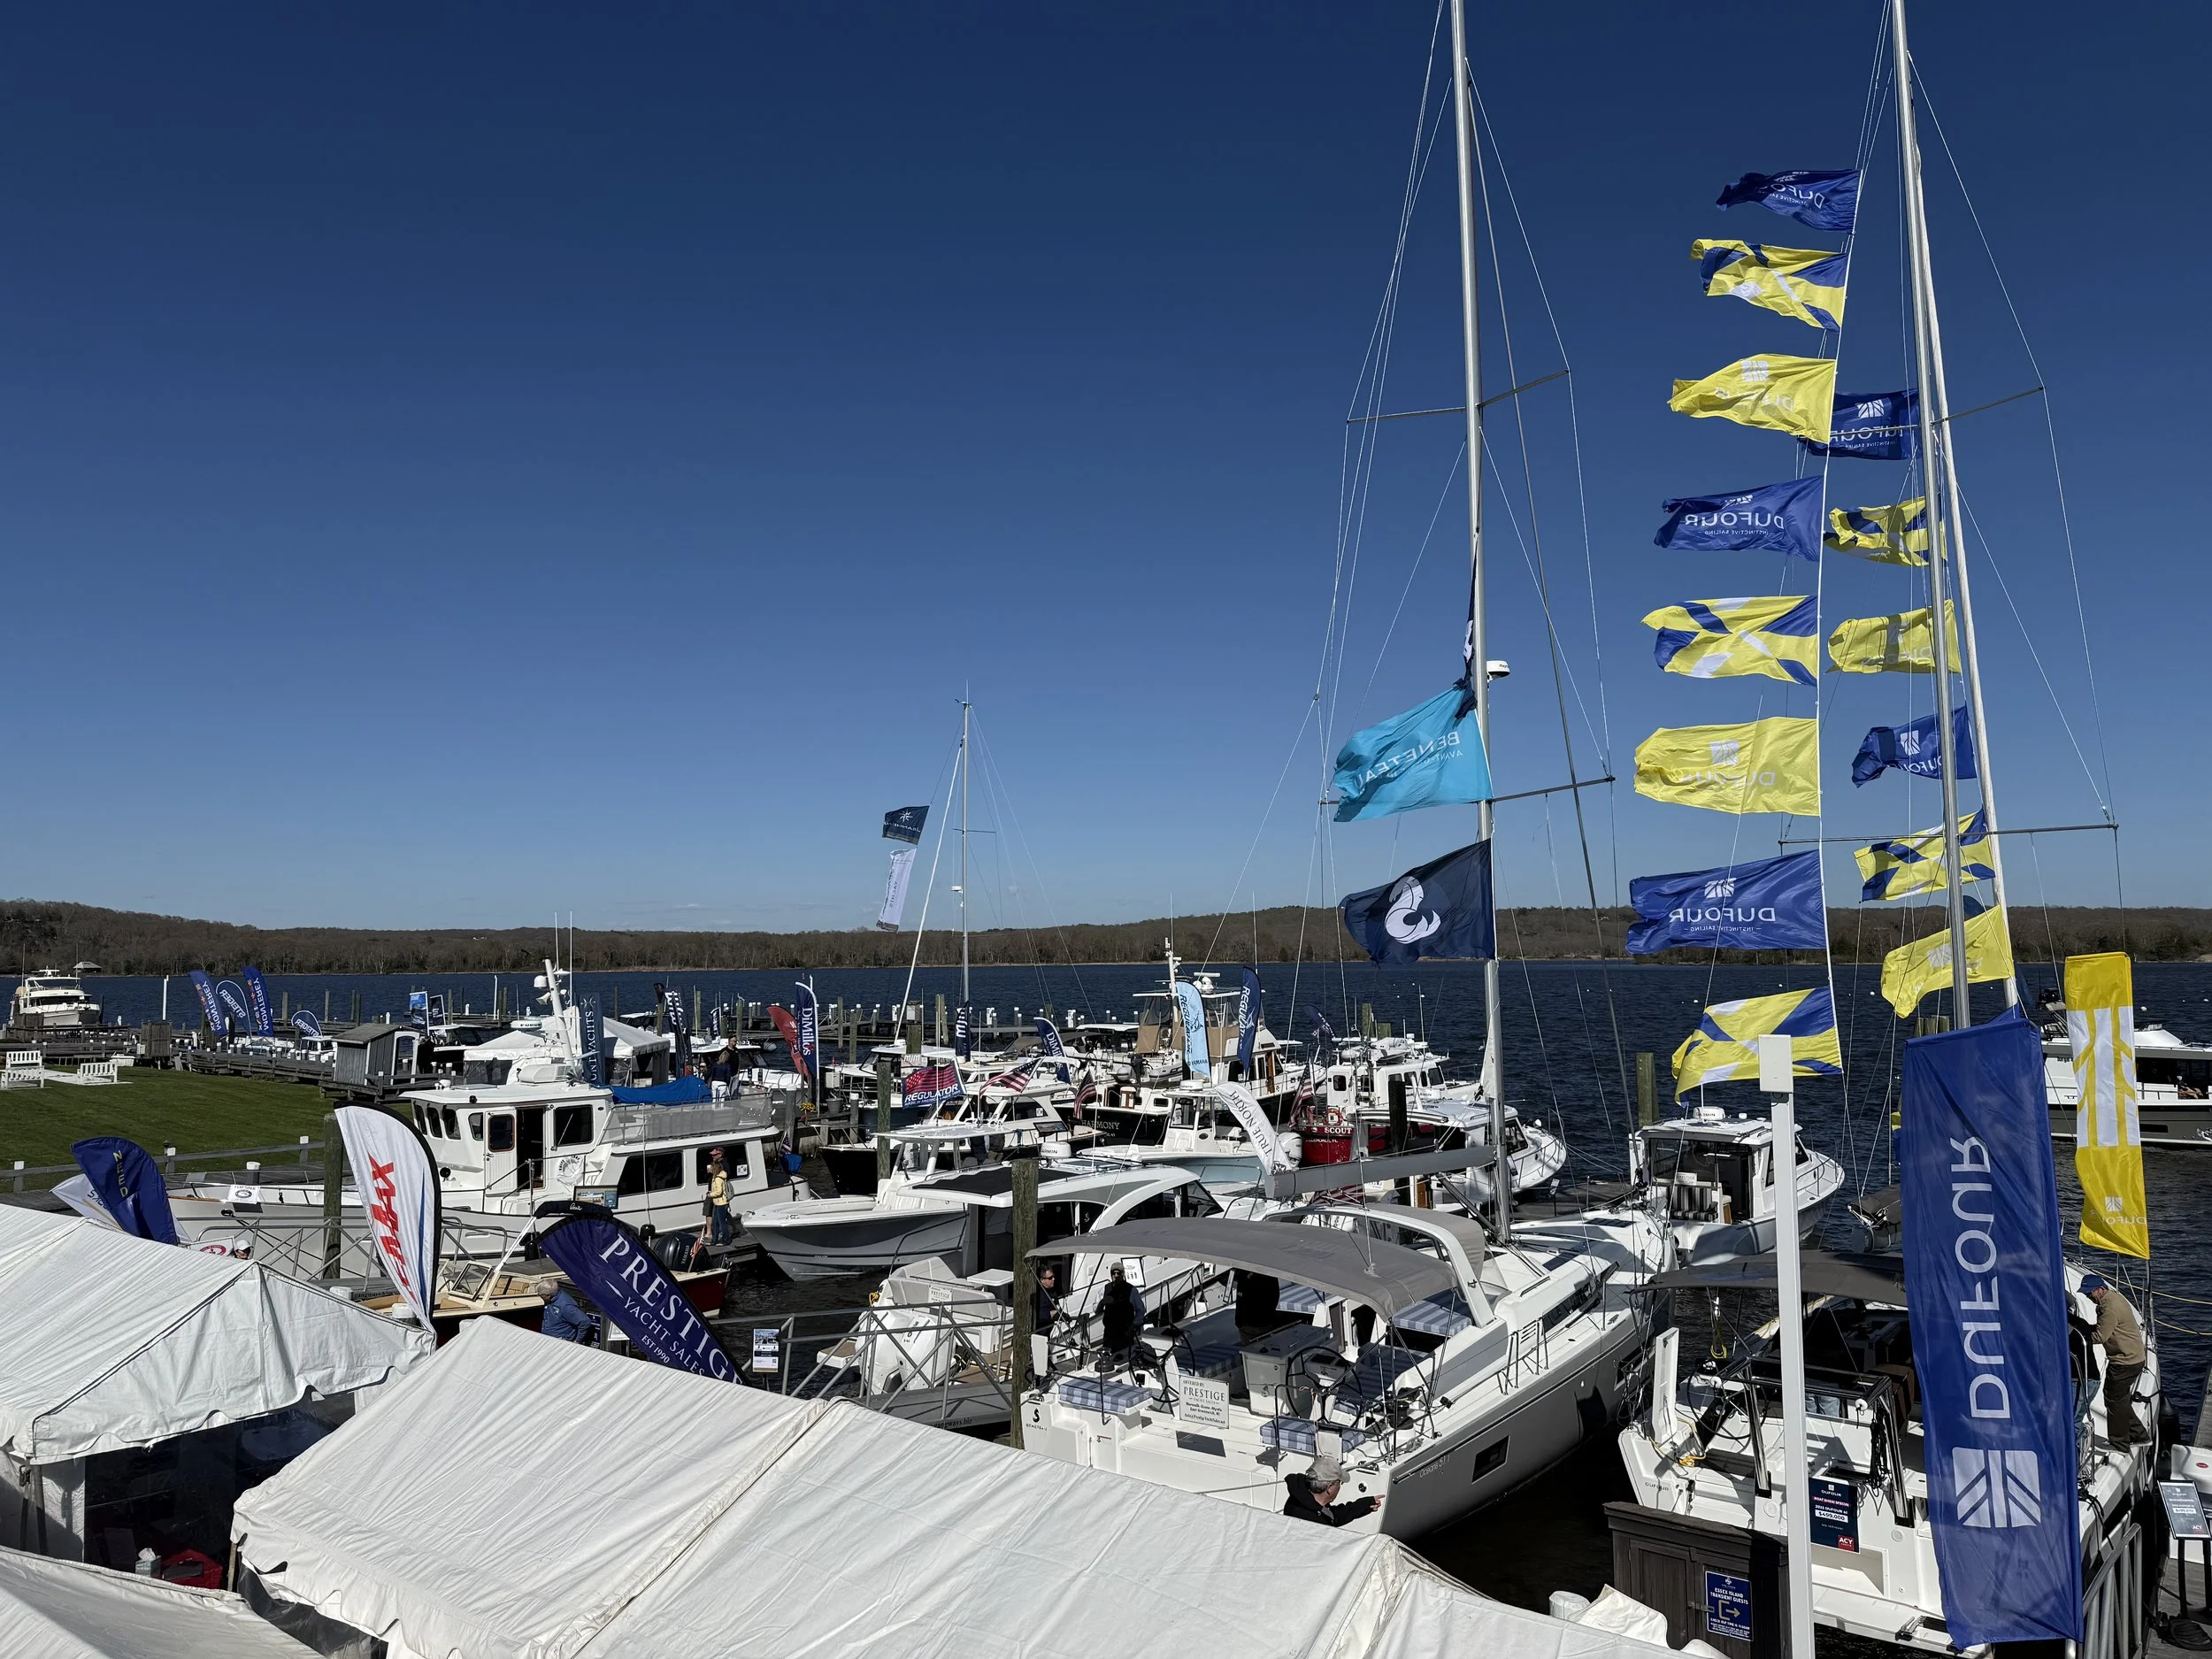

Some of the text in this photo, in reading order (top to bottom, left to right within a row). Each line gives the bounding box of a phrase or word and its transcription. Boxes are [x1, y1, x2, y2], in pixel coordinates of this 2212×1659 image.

[586, 1010, 597, 1081] UNT YACHTS
[905, 1084, 958, 1102] REGULATOR
[1082, 1120, 1120, 1130] HARMONY
[1229, 1090, 1272, 1157] TRUE NORTH
[680, 1245, 689, 1264] YAMAHA
[623, 1296, 671, 1341] YACHT
[669, 1340, 706, 1376] SALES
[641, 1334, 671, 1363] EST 1990
[1183, 1386, 1225, 1402] PRESTIGE
[1818, 1511, 1845, 1521] $499,000
[1710, 1592, 1748, 1605] TRANSIENT GUESTS
